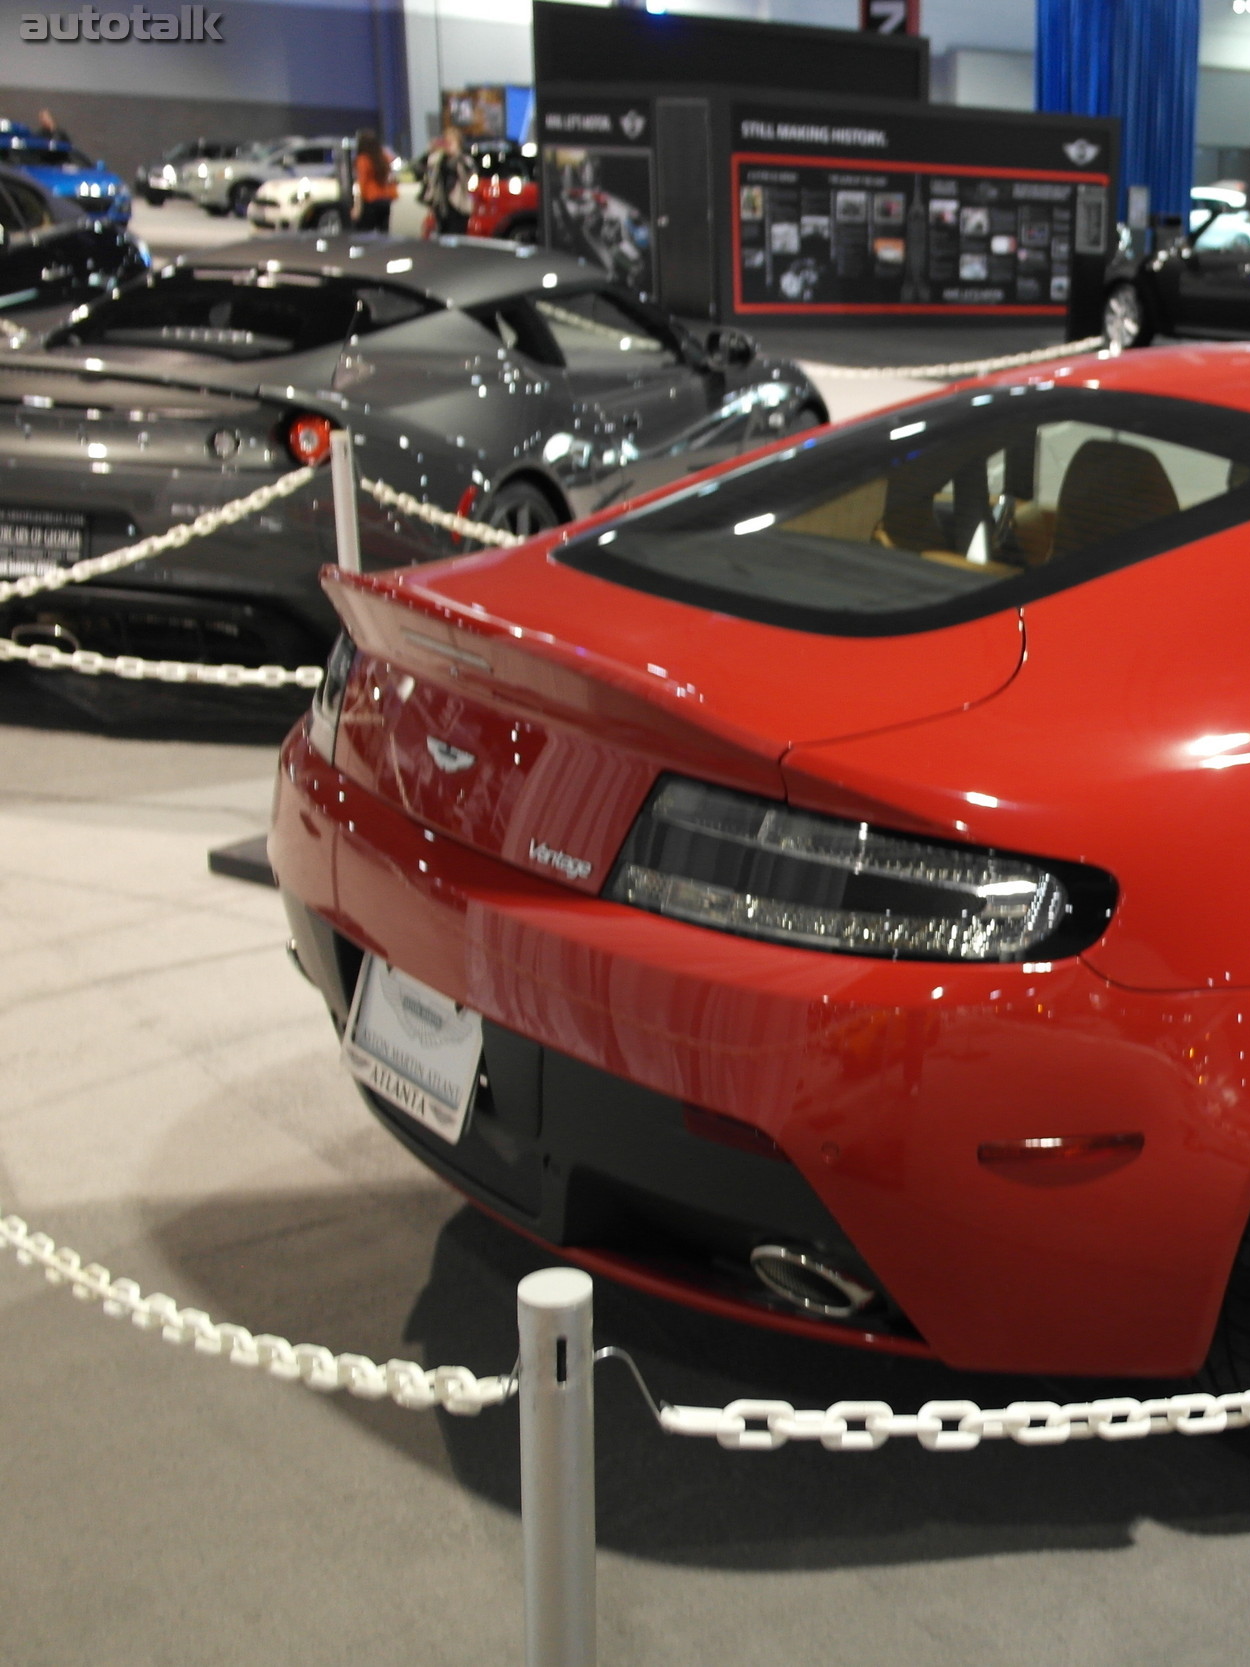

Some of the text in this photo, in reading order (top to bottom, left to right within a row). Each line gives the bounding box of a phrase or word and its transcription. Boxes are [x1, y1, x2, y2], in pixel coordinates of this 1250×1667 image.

[741, 119, 775, 140] STILL
[776, 123, 829, 145] MAKING
[528, 836, 593, 880] Vantage
[371, 1063, 426, 1117] ATLANTA
